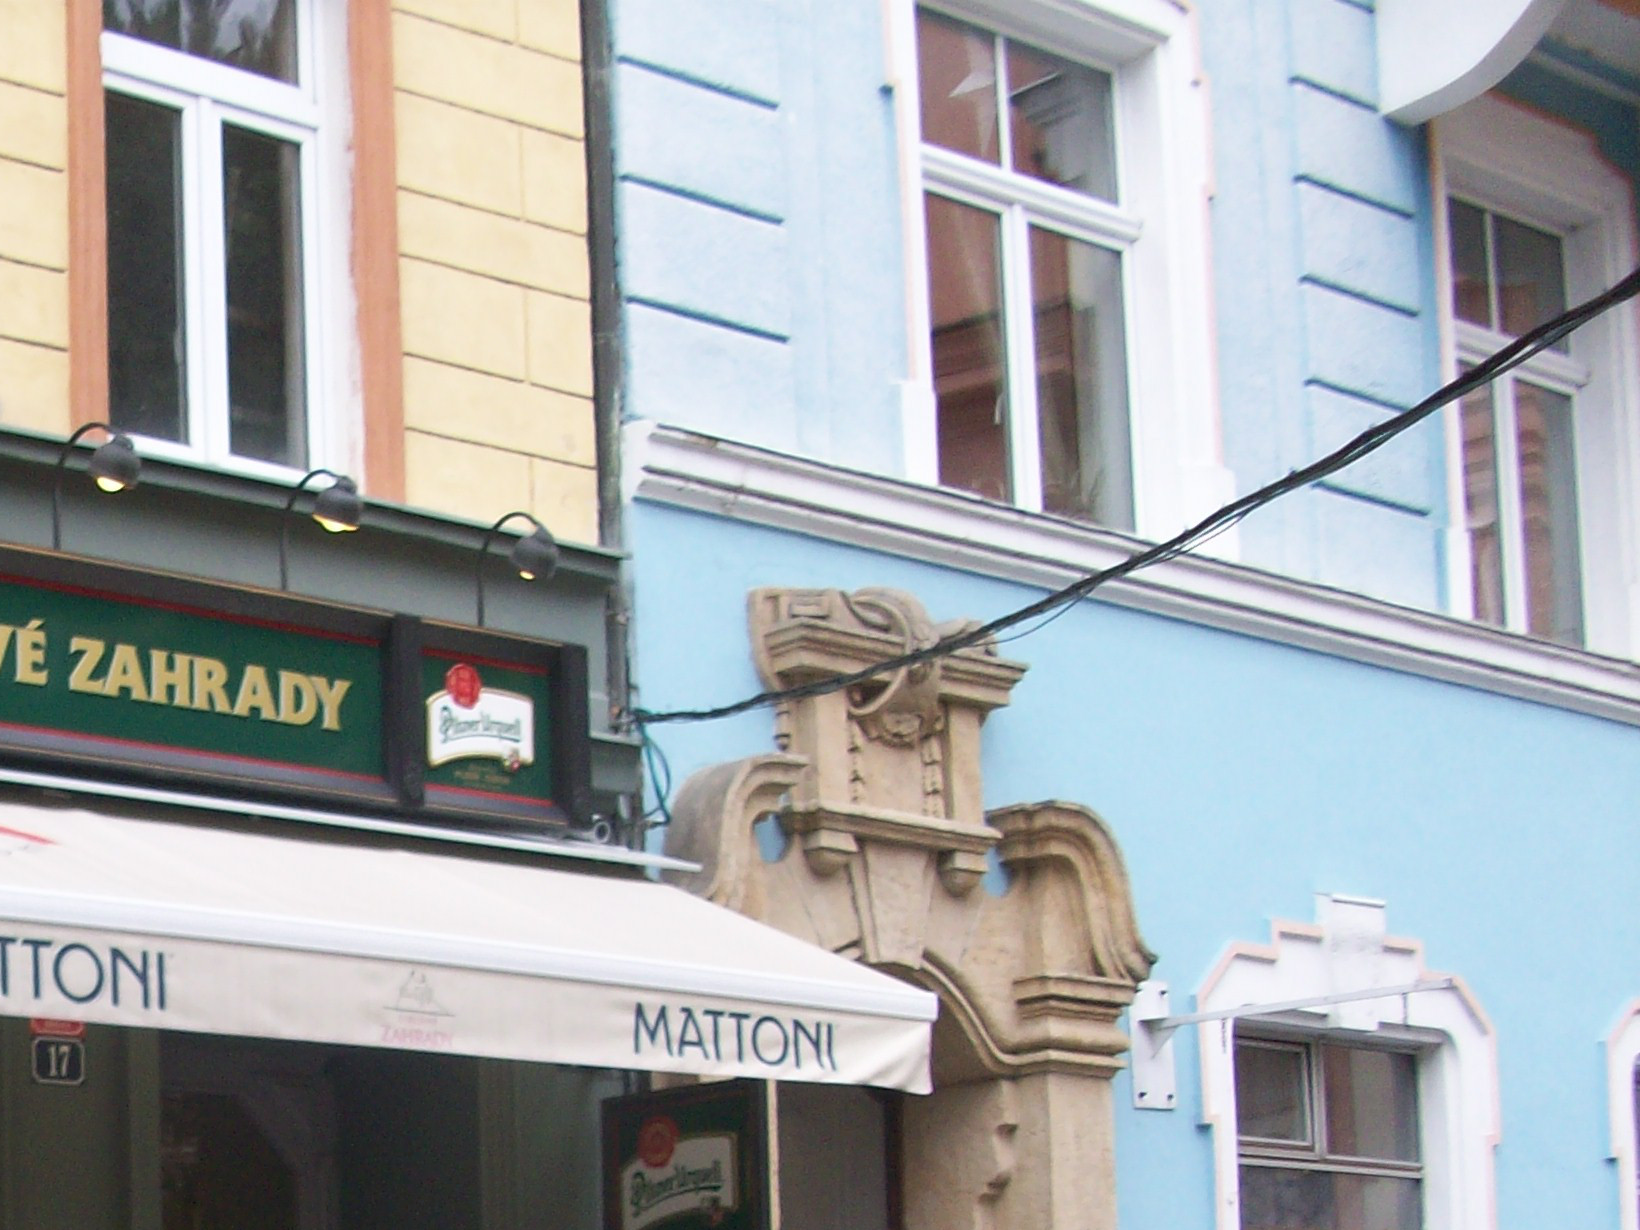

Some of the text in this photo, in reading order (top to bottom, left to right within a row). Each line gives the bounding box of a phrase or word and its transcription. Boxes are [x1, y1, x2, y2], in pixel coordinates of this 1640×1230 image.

[68, 636, 351, 731] ZAHRADY
[47, 1045, 70, 1078] 17
[633, 1001, 839, 1072] MATTONI
